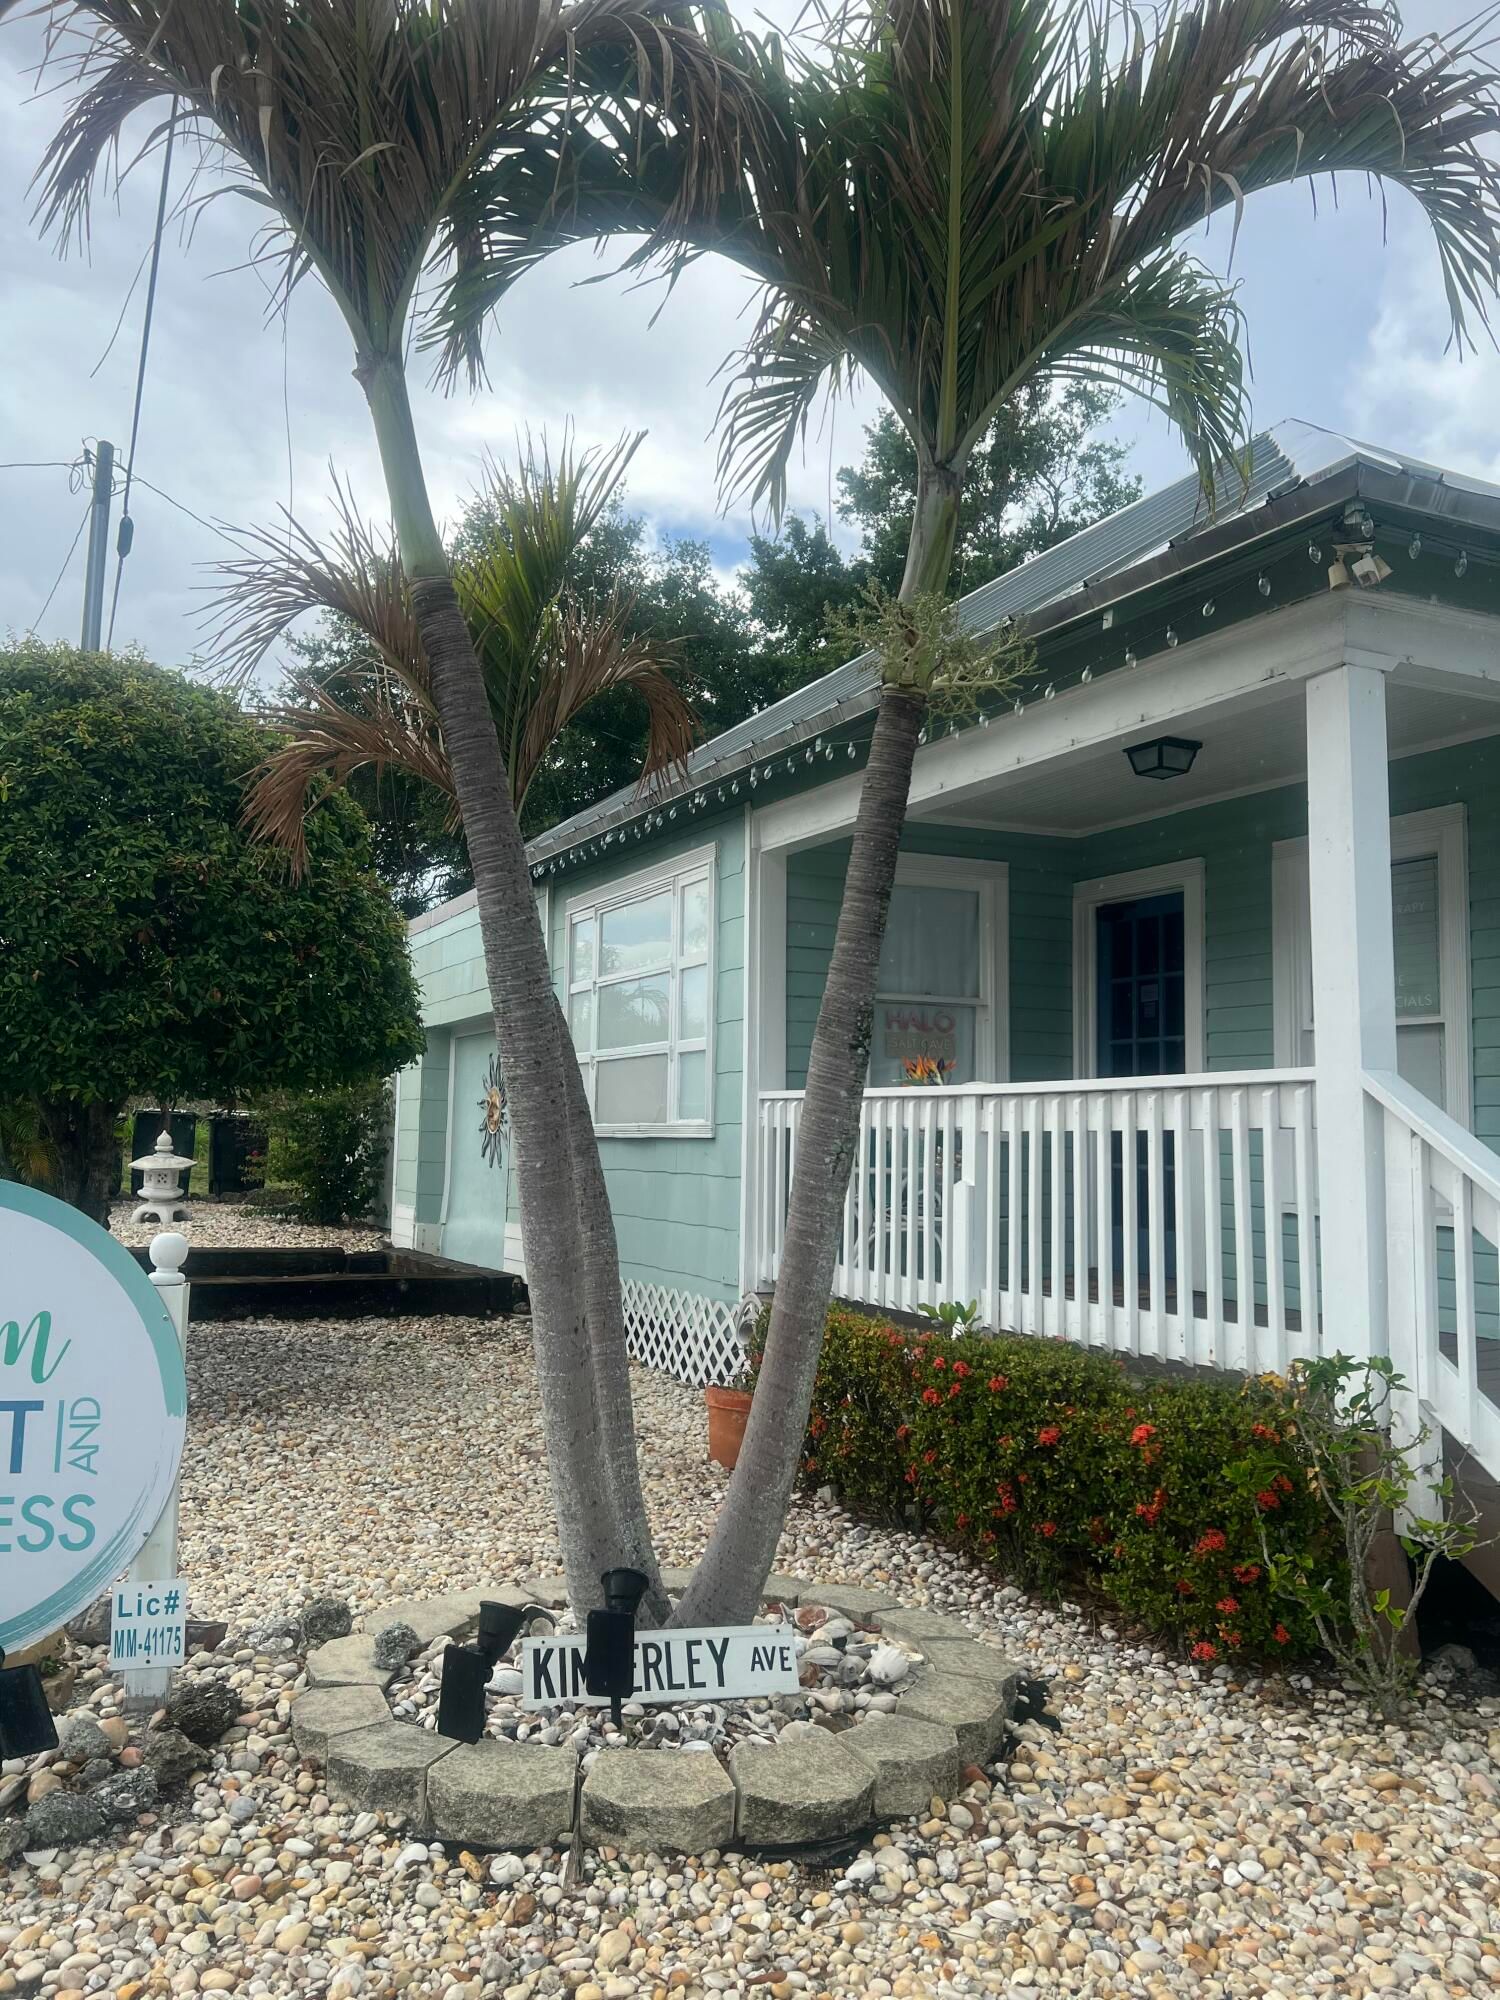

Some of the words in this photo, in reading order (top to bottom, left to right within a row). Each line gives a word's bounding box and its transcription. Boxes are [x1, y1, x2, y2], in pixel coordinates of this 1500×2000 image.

[886, 1009, 955, 1033] HALO
[889, 1037, 917, 1049] SALT
[921, 1038, 950, 1050] CAVE
[67, 1396, 101, 1476] AND
[118, 1590, 180, 1618] Lic#
[114, 1626, 181, 1659] MM-41175
[533, 1637, 729, 1699] KIMRLEY
[751, 1646, 792, 1672] AVE
